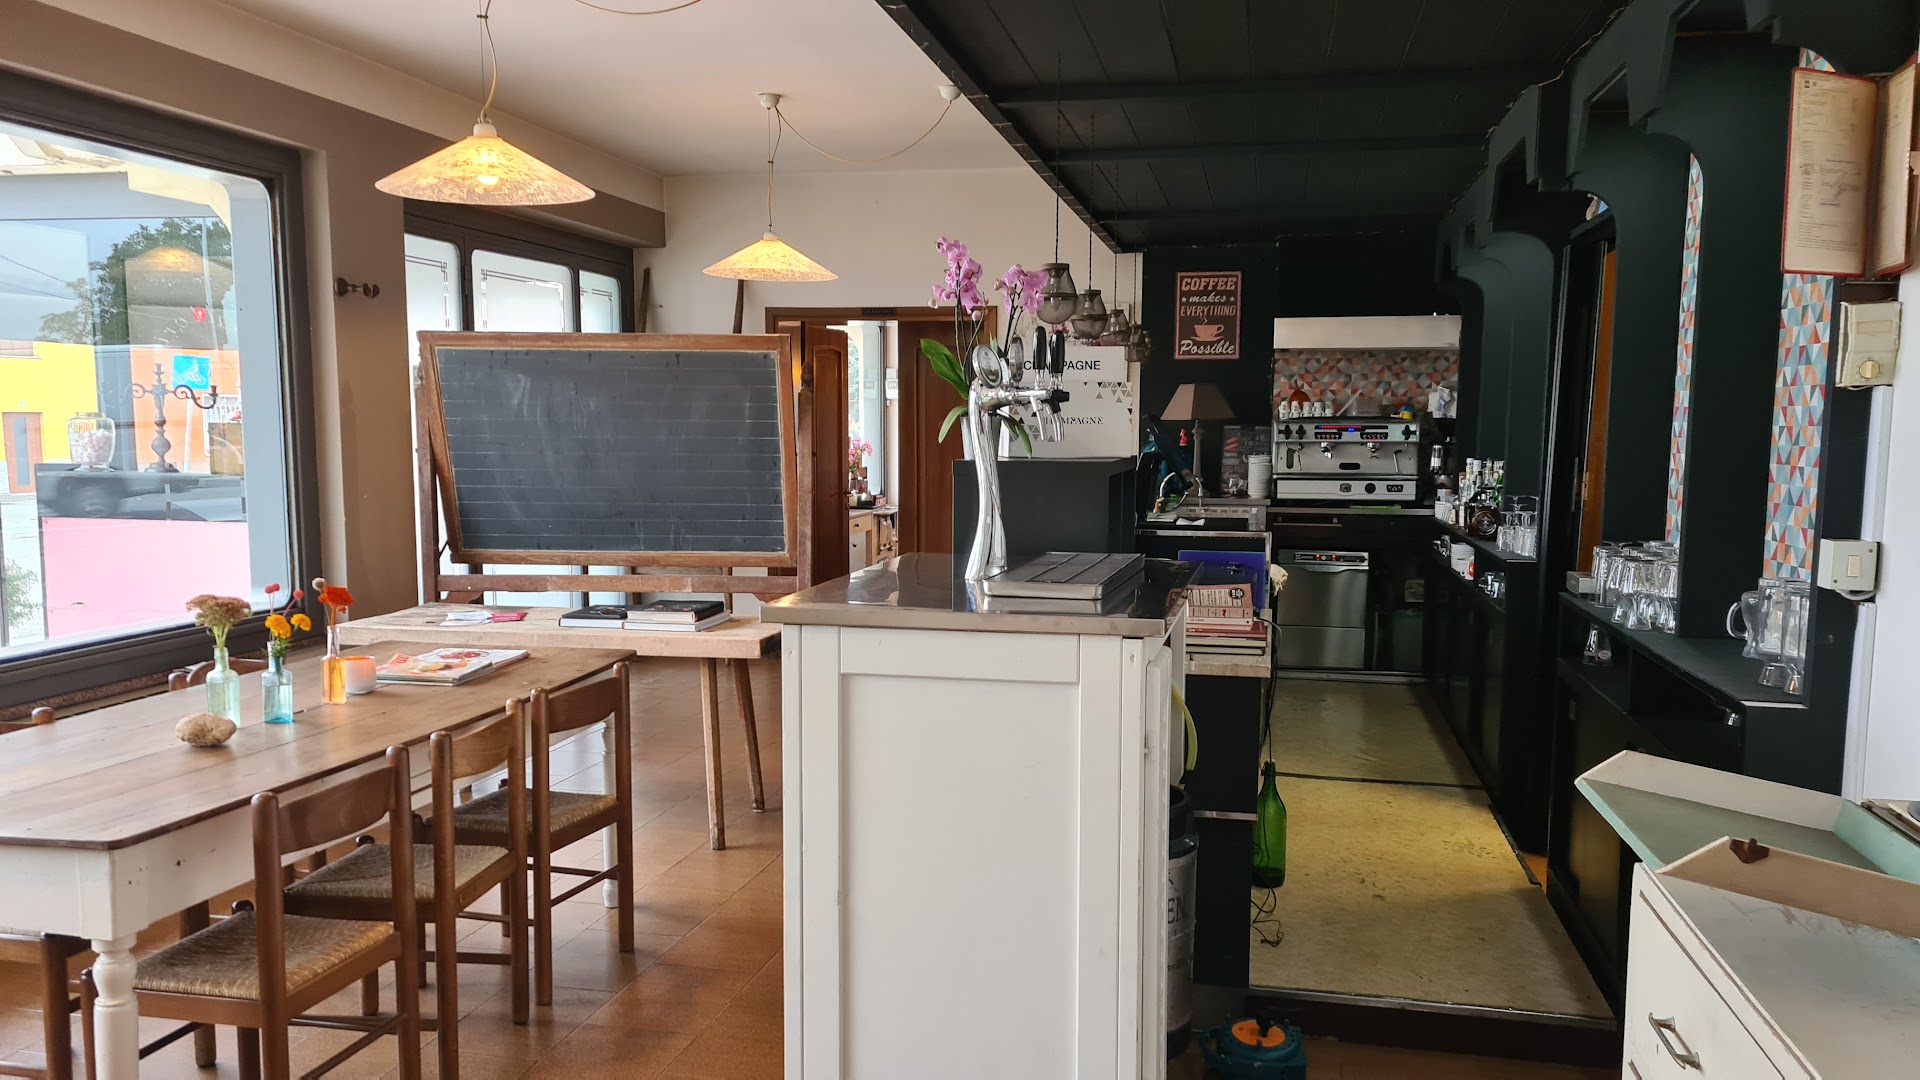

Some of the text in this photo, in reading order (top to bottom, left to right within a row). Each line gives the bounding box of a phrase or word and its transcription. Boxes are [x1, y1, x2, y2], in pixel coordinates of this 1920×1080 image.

[1181, 277, 1237, 291] COFFEE
[1189, 291, 1227, 303] makes
[1180, 305, 1237, 317] EVERYTHING
[1180, 340, 1235, 354] Possible
[1023, 360, 1101, 371] CPAGNE
